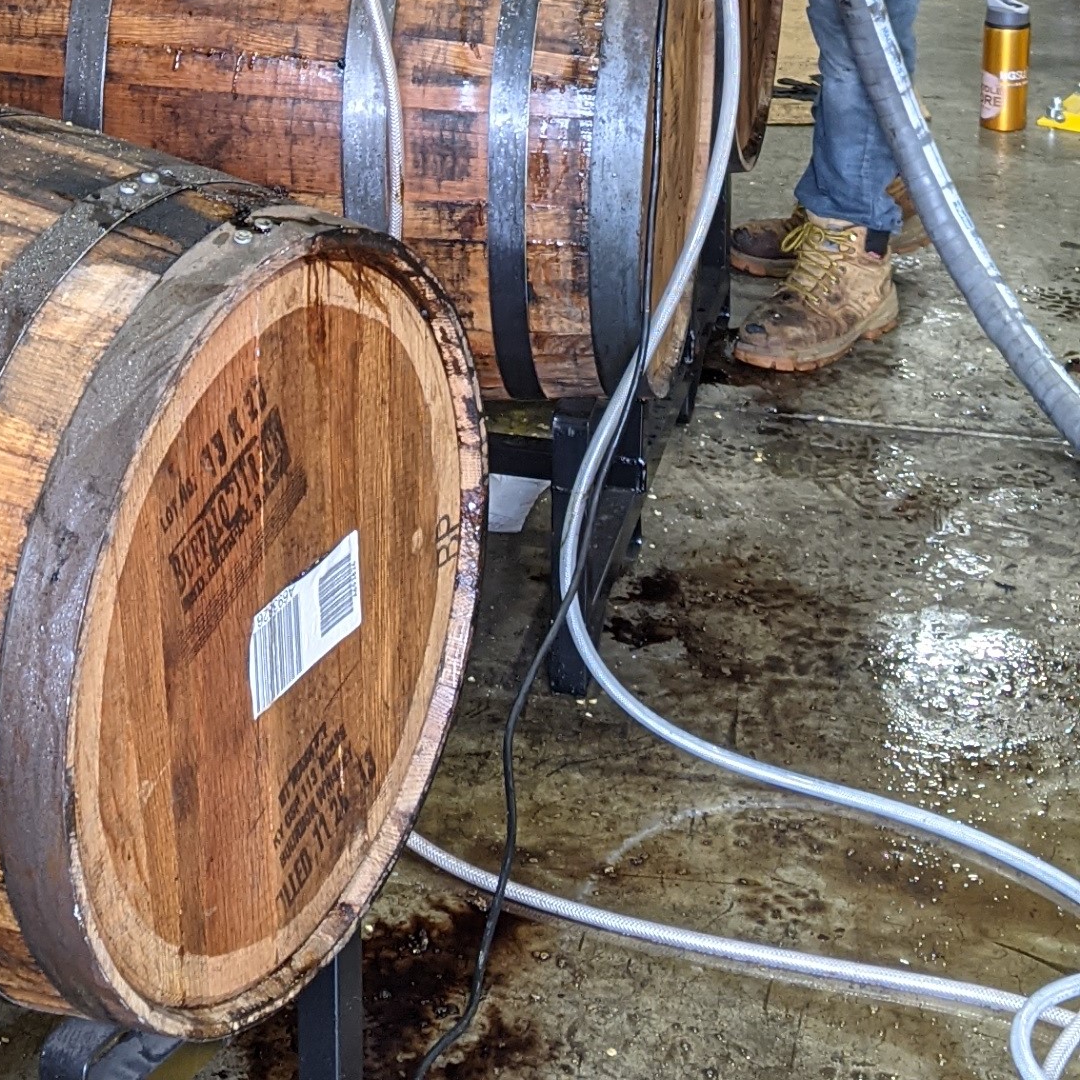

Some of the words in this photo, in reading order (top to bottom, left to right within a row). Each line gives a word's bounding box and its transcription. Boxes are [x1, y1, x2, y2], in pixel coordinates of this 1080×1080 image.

[160, 498, 178, 533] LOT
[168, 491, 231, 594] BUFFALO
[311, 810, 333, 855] 11
